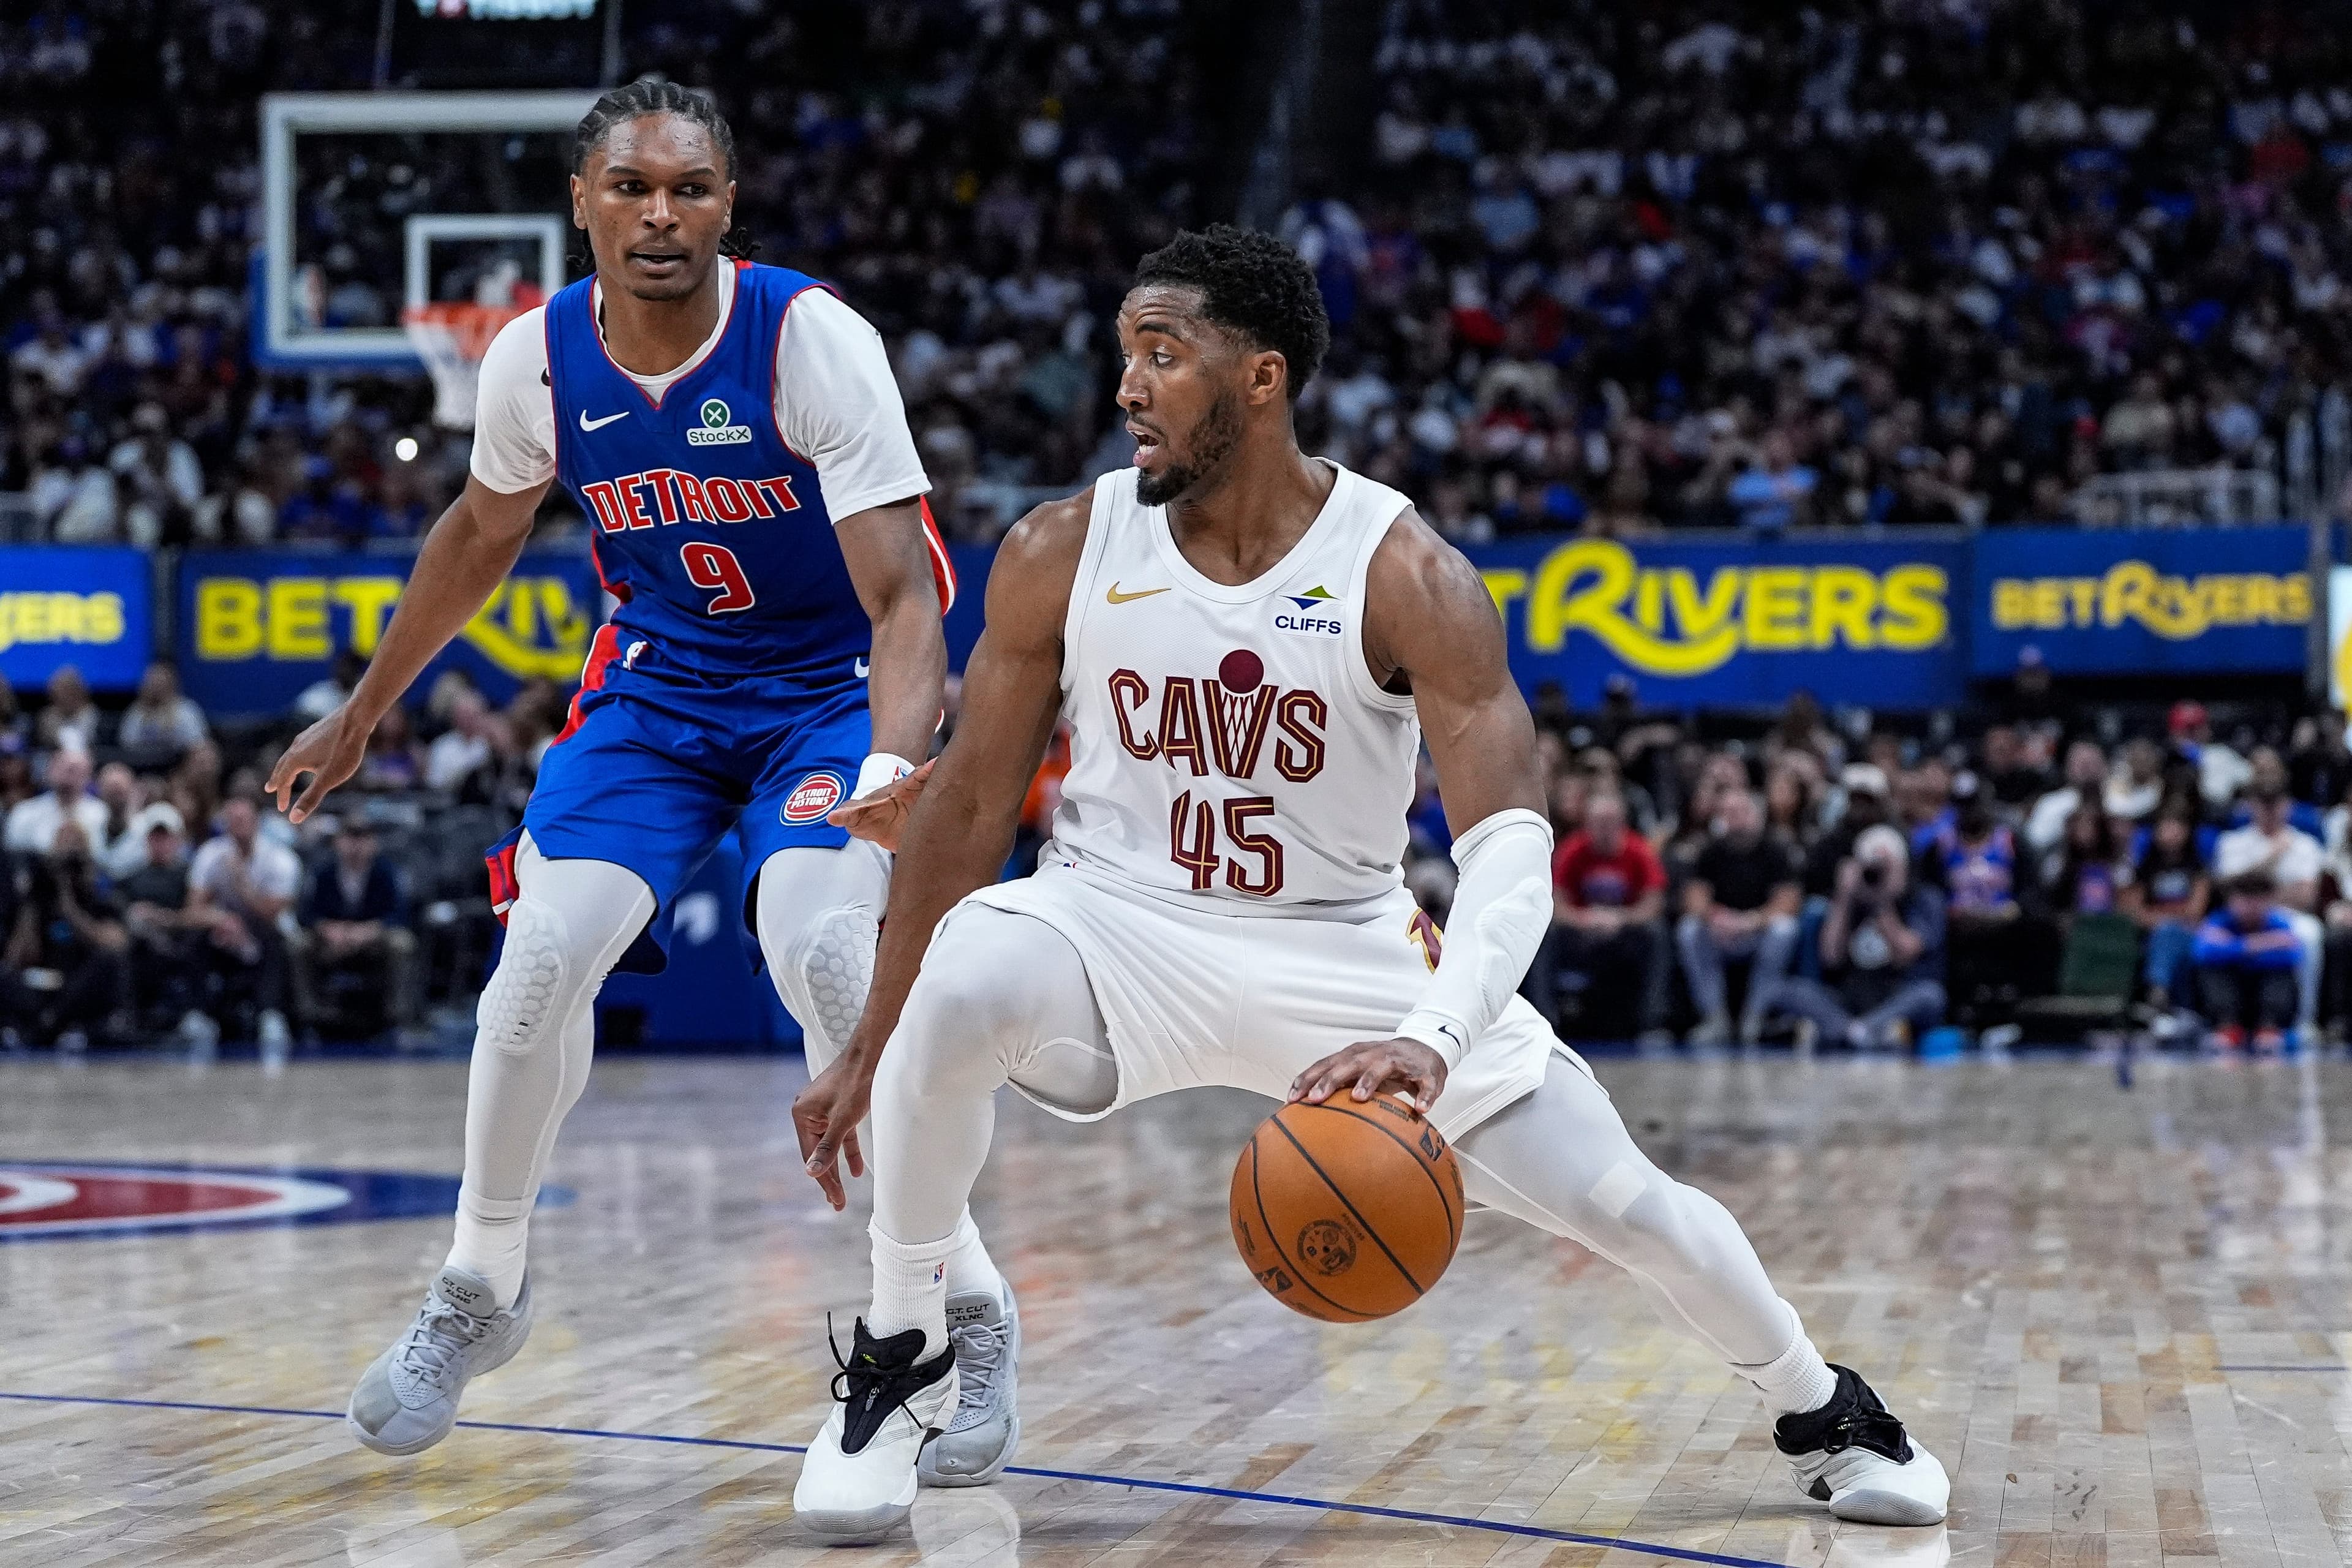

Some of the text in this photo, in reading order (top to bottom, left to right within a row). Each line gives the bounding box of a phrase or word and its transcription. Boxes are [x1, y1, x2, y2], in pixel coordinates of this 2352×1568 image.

[690, 428, 749, 443] StockX
[581, 469, 801, 533] DETROIT
[680, 541, 755, 615] 9
[1275, 616, 1341, 635] CLIFFS
[1107, 666, 1327, 783] CAVS
[790, 797, 830, 809] PISTONS
[794, 788, 833, 801] DETROIT
[1170, 790, 1283, 897] 45
[967, 1303, 990, 1313] CUT
